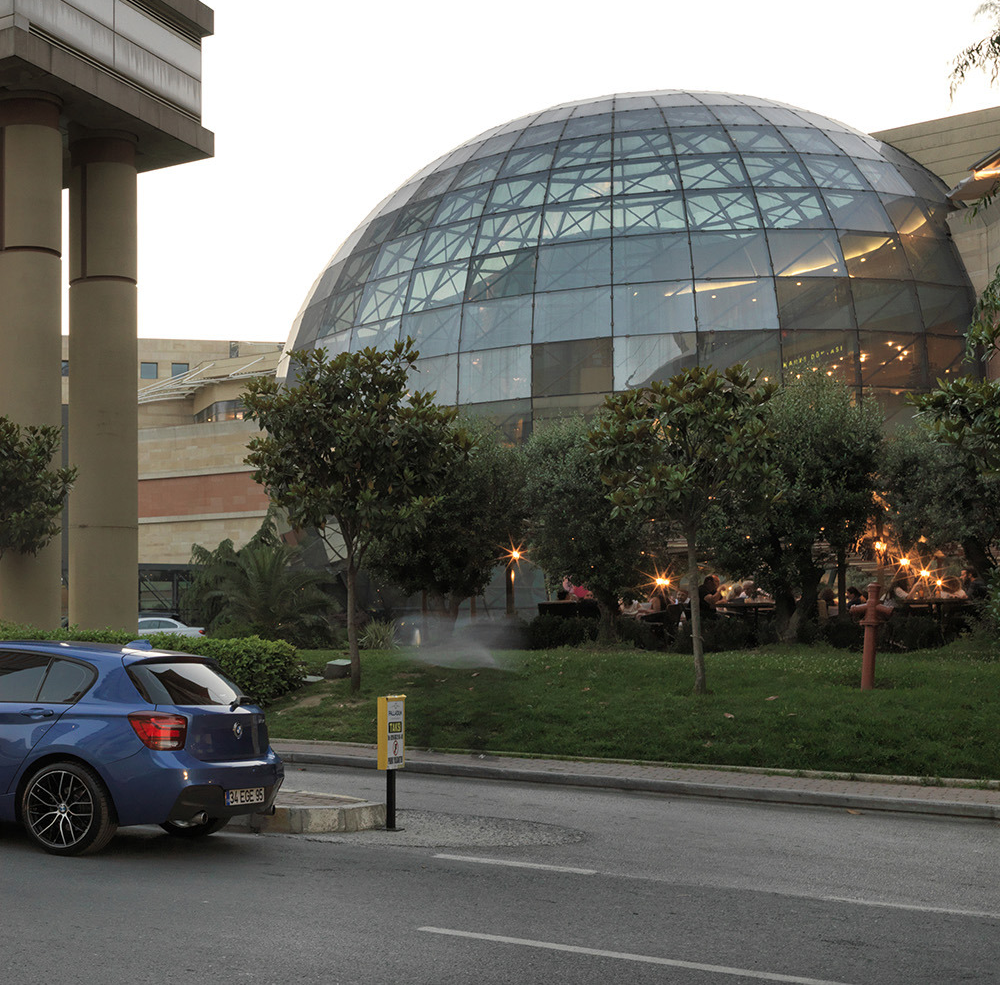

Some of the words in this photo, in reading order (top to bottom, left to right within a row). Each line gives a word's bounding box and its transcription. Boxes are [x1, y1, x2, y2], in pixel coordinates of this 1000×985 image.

[230, 790, 239, 804] 34
[240, 789, 255, 803] EGE
[256, 788, 264, 802] 95
